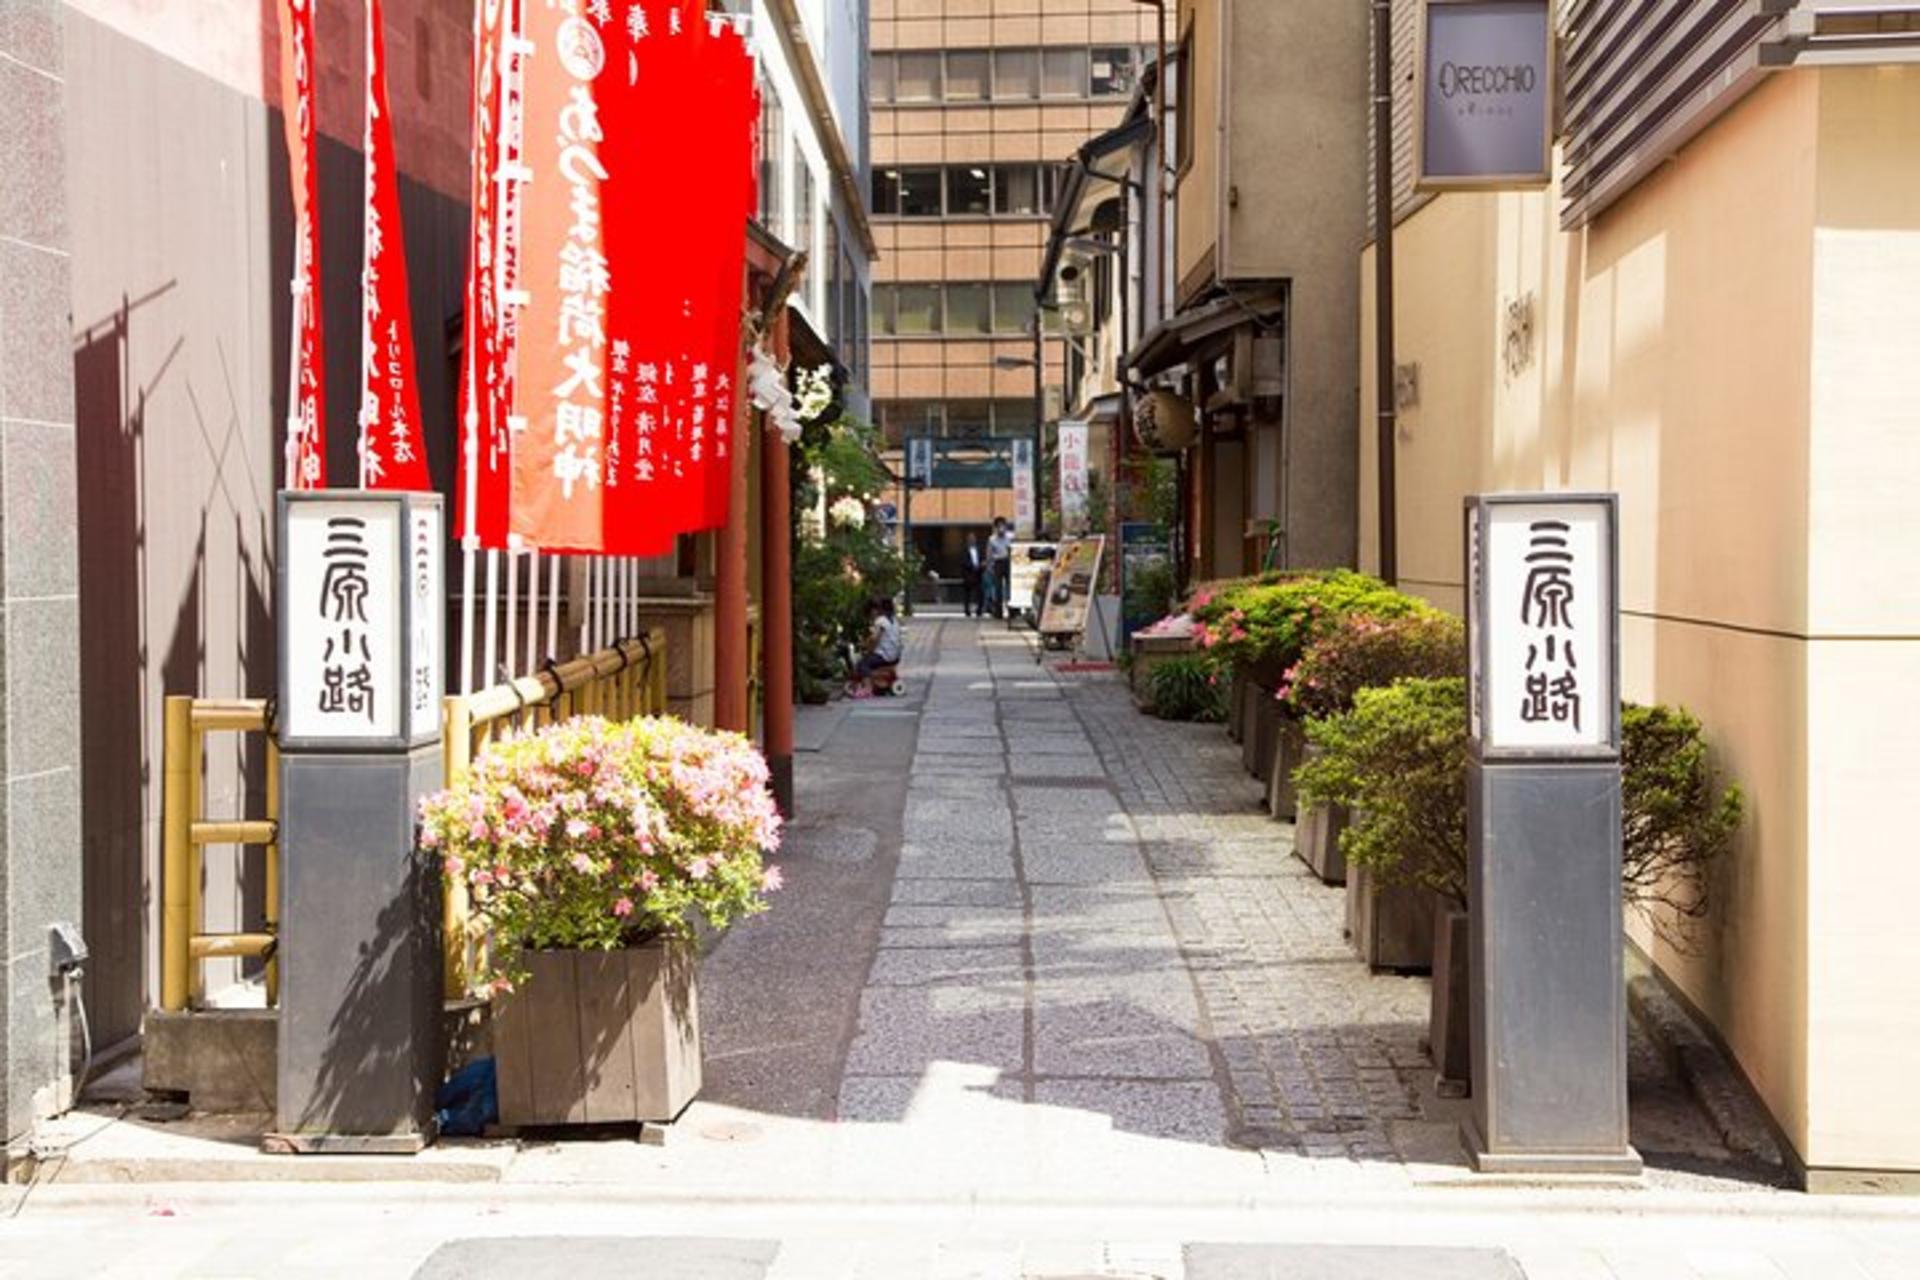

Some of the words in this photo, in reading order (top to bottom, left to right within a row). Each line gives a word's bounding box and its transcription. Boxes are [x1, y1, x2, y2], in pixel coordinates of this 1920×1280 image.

[1439, 60, 1536, 99] ORECCHIO
[319, 517, 375, 724] 三原小路
[1520, 521, 1580, 733] 三原小路
